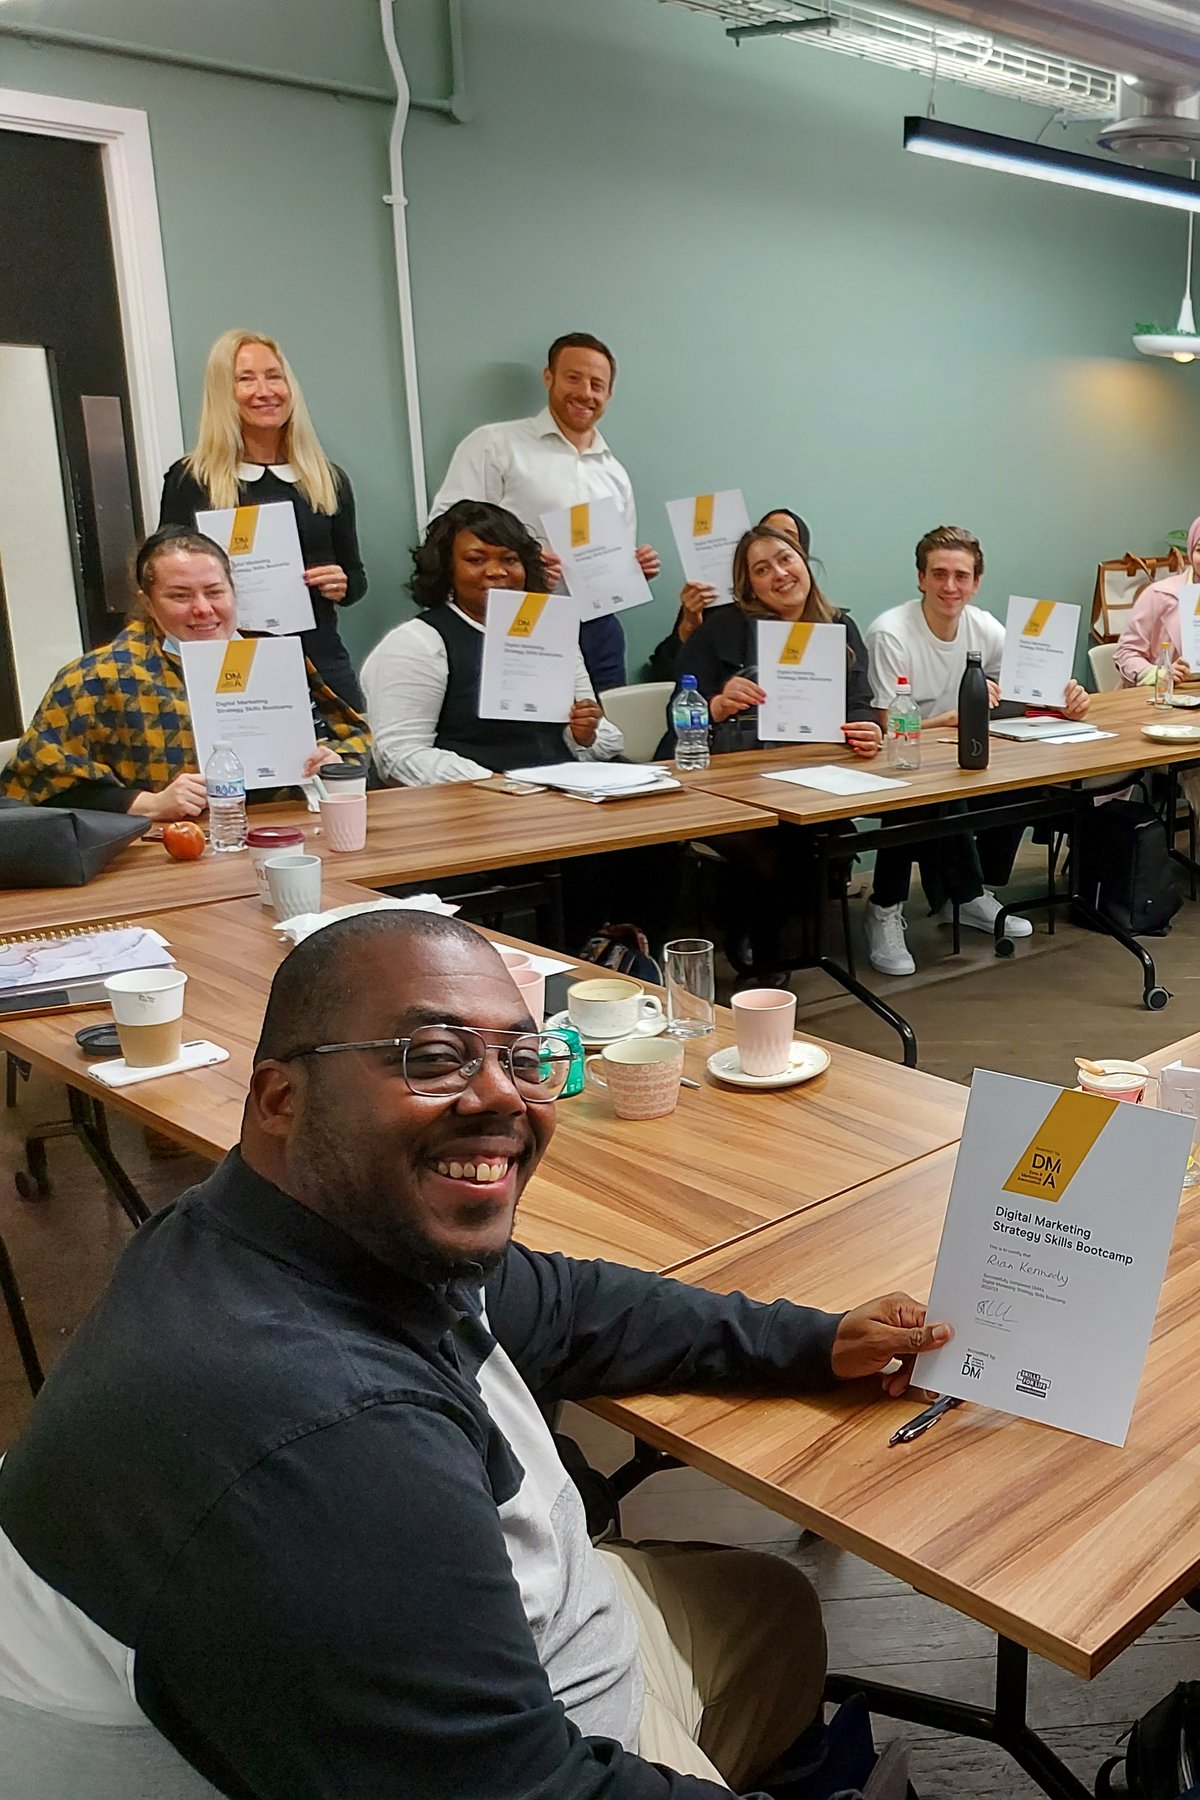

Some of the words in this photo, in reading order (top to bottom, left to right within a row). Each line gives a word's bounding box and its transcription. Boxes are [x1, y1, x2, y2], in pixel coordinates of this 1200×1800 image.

[995, 1206, 1032, 1223] Digital
[1034, 1215, 1092, 1240] Marketing
[992, 1221, 1041, 1243] Strategy
[1044, 1233, 1073, 1249] Skills
[1076, 1241, 1133, 1266] Bootcamp
